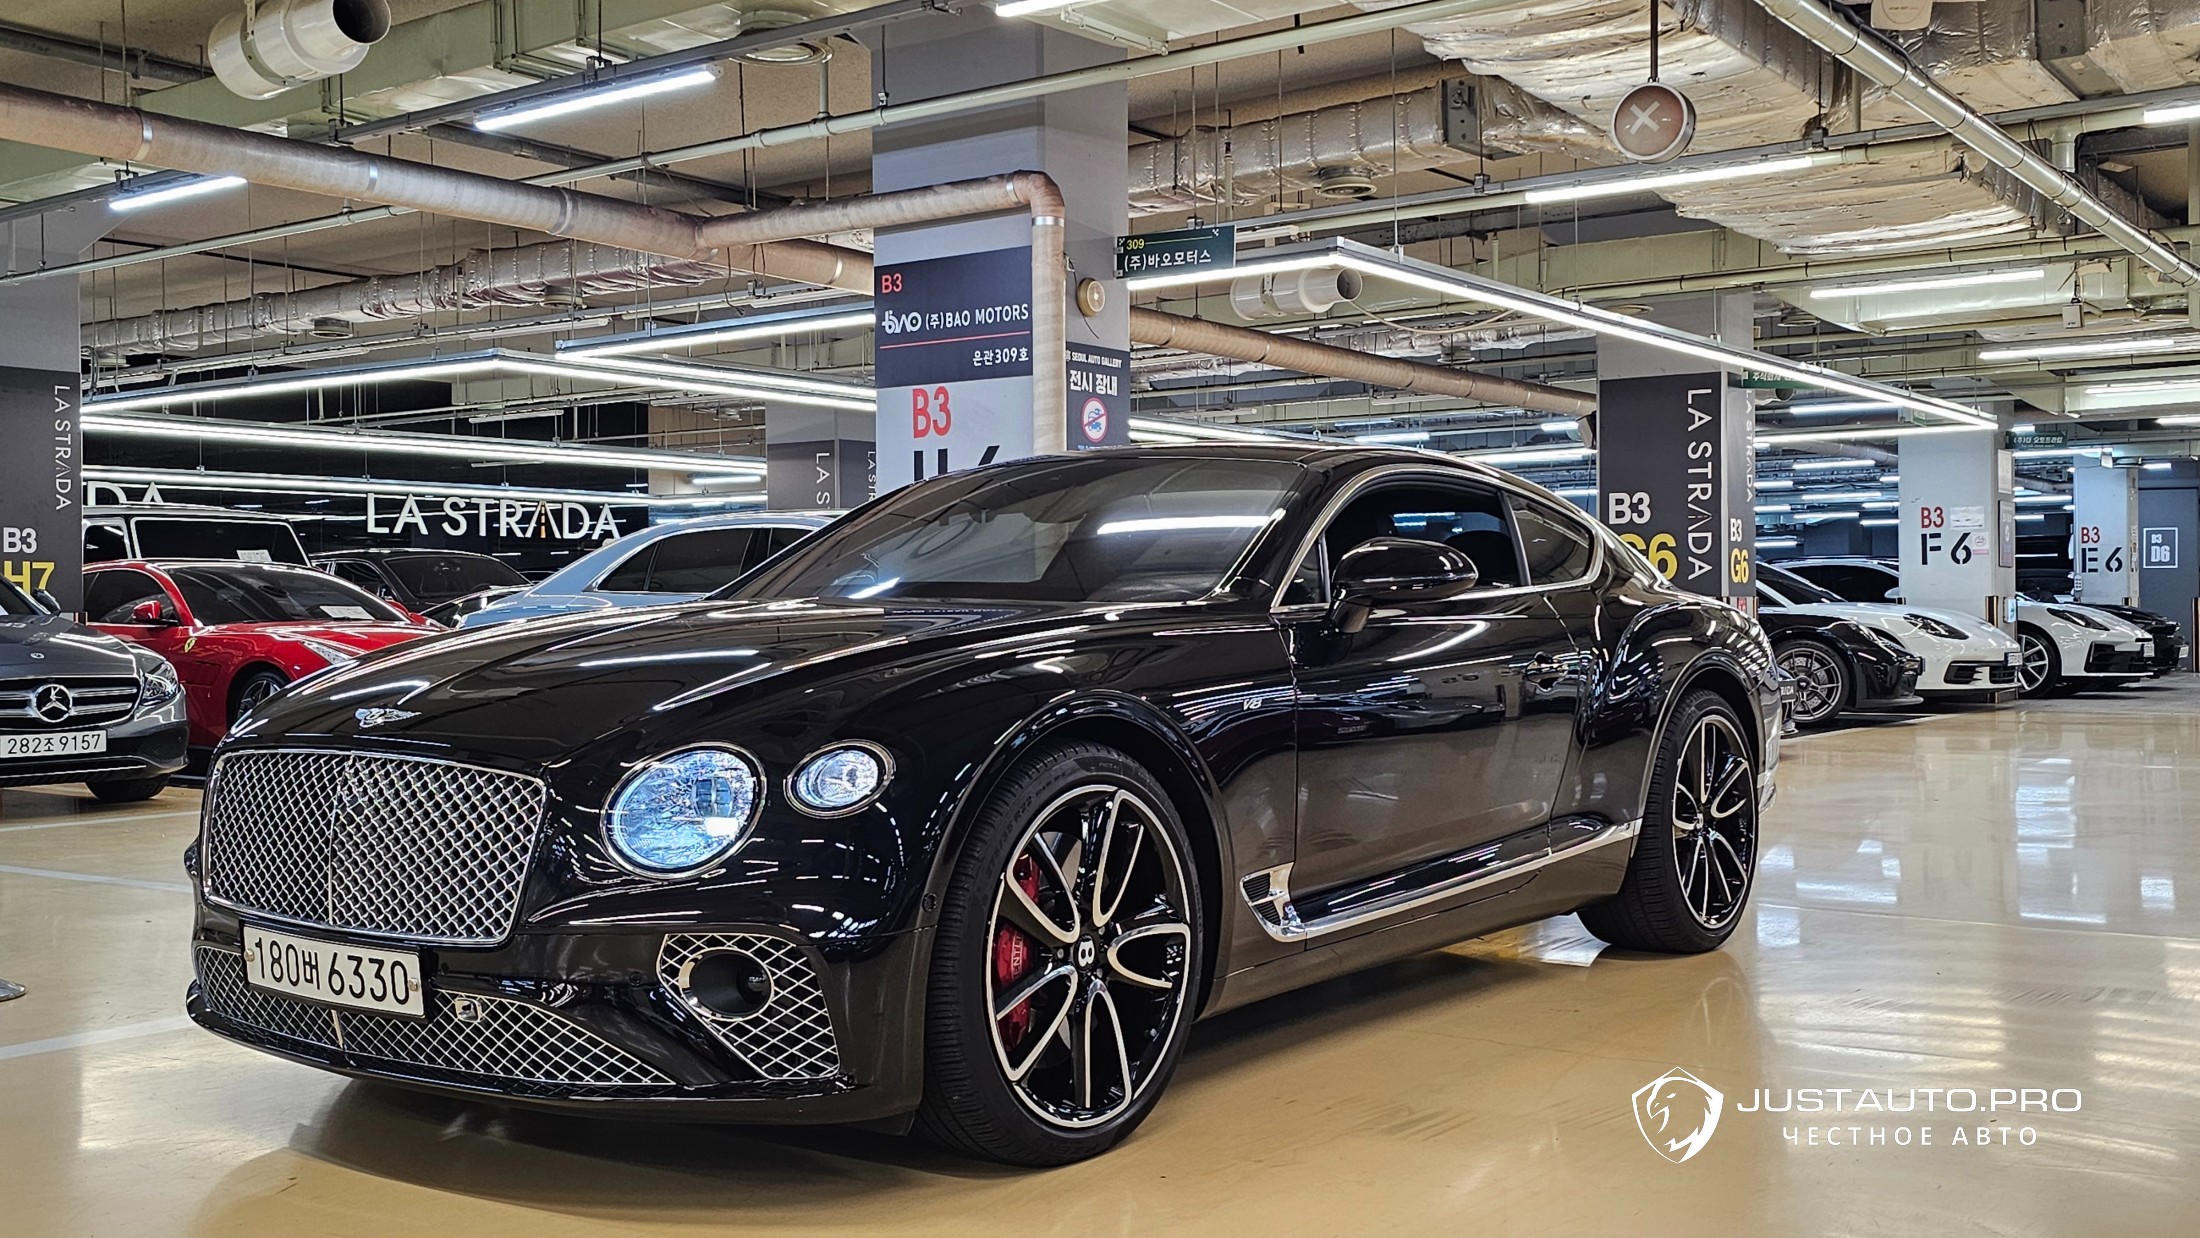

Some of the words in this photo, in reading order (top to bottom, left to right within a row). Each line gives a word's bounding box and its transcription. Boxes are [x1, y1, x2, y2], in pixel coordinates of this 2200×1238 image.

[1126, 238, 1145, 251] 309
[1124, 249, 1212, 272] (주)바오모터스
[881, 272, 903, 294] B3
[925, 310, 971, 331] (주)BAO
[975, 303, 1029, 325] MOTORS
[972, 346, 1029, 367] 은관309호
[1071, 352, 1088, 362] SEOUL
[1088, 354, 1101, 366] AUTO
[1101, 356, 1123, 369] GALLERY
[1069, 369, 1093, 393] 전시
[1095, 373, 1118, 397] 장내
[54, 384, 71, 413] LA
[912, 385, 952, 439] B3
[1687, 388, 1713, 432] LA
[54, 419, 72, 511] STRADA
[815, 452, 831, 485] LA
[367, 493, 429, 535] LA
[441, 496, 621, 540] STRADA
[1608, 491, 1651, 525] B3
[1687, 441, 1713, 581] STRADA
[1921, 506, 1945, 529] B3
[3, 527, 37, 553] B3
[1730, 518, 1742, 543] B3
[2081, 526, 2100, 544] B3
[2151, 533, 2163, 544] B3
[1730, 547, 1749, 584] G6
[2150, 545, 2171, 563] D6
[3, 560, 55, 595] H7
[7, 737, 54, 755] 282조
[59, 733, 101, 752] 9157
[254, 937, 321, 991] 180버
[328, 951, 410, 1005] 6330
